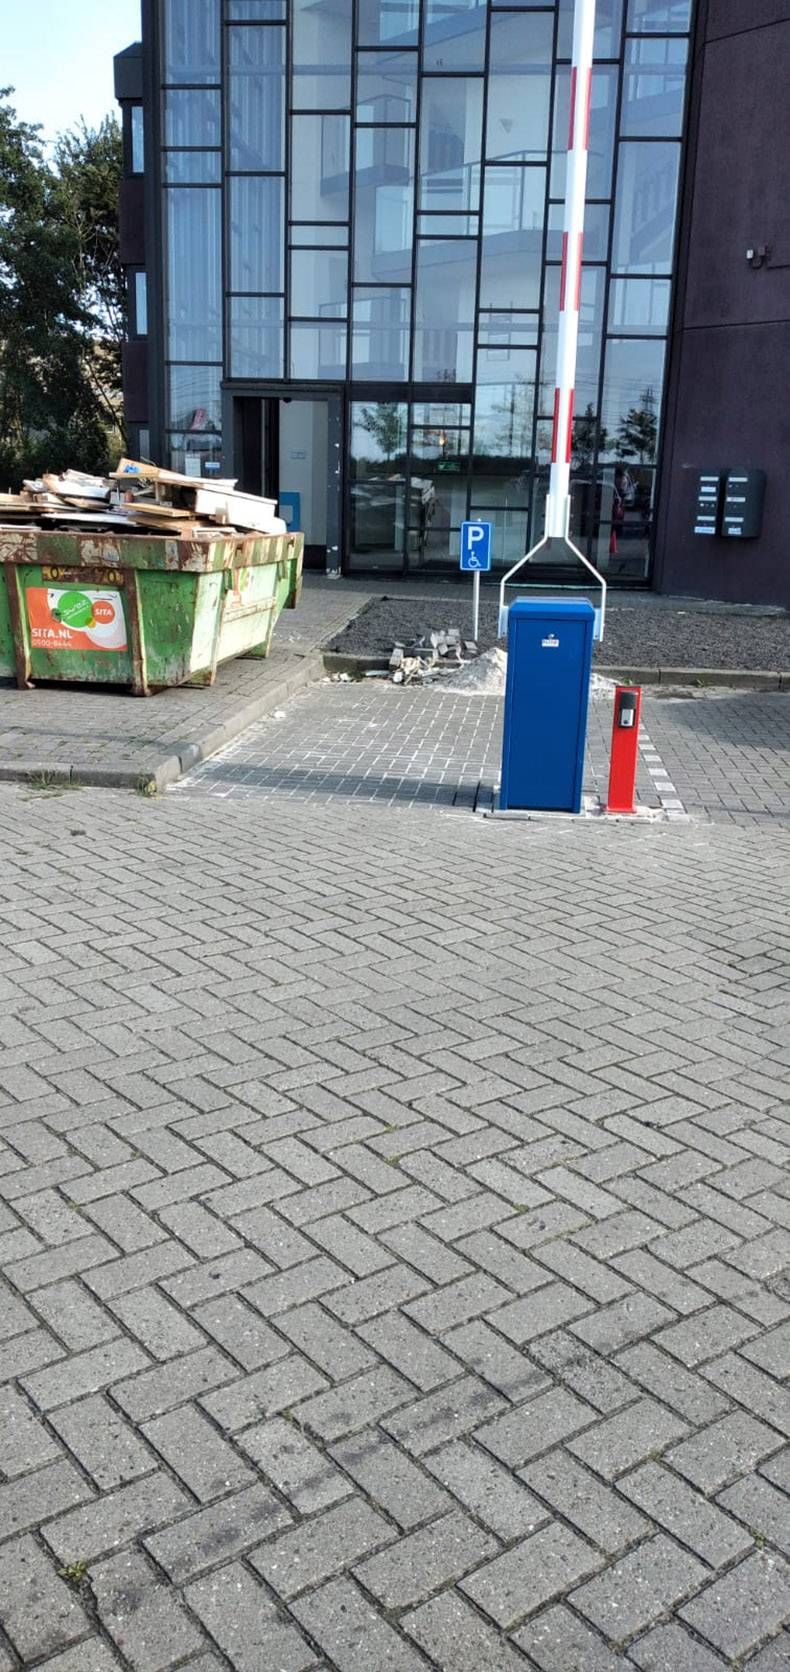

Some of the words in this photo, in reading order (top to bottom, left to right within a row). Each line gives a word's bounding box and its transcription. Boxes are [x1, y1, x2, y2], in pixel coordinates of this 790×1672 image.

[468, 526, 485, 550] P
[95, 608, 112, 616] SITA
[32, 628, 73, 639] SITA.NL
